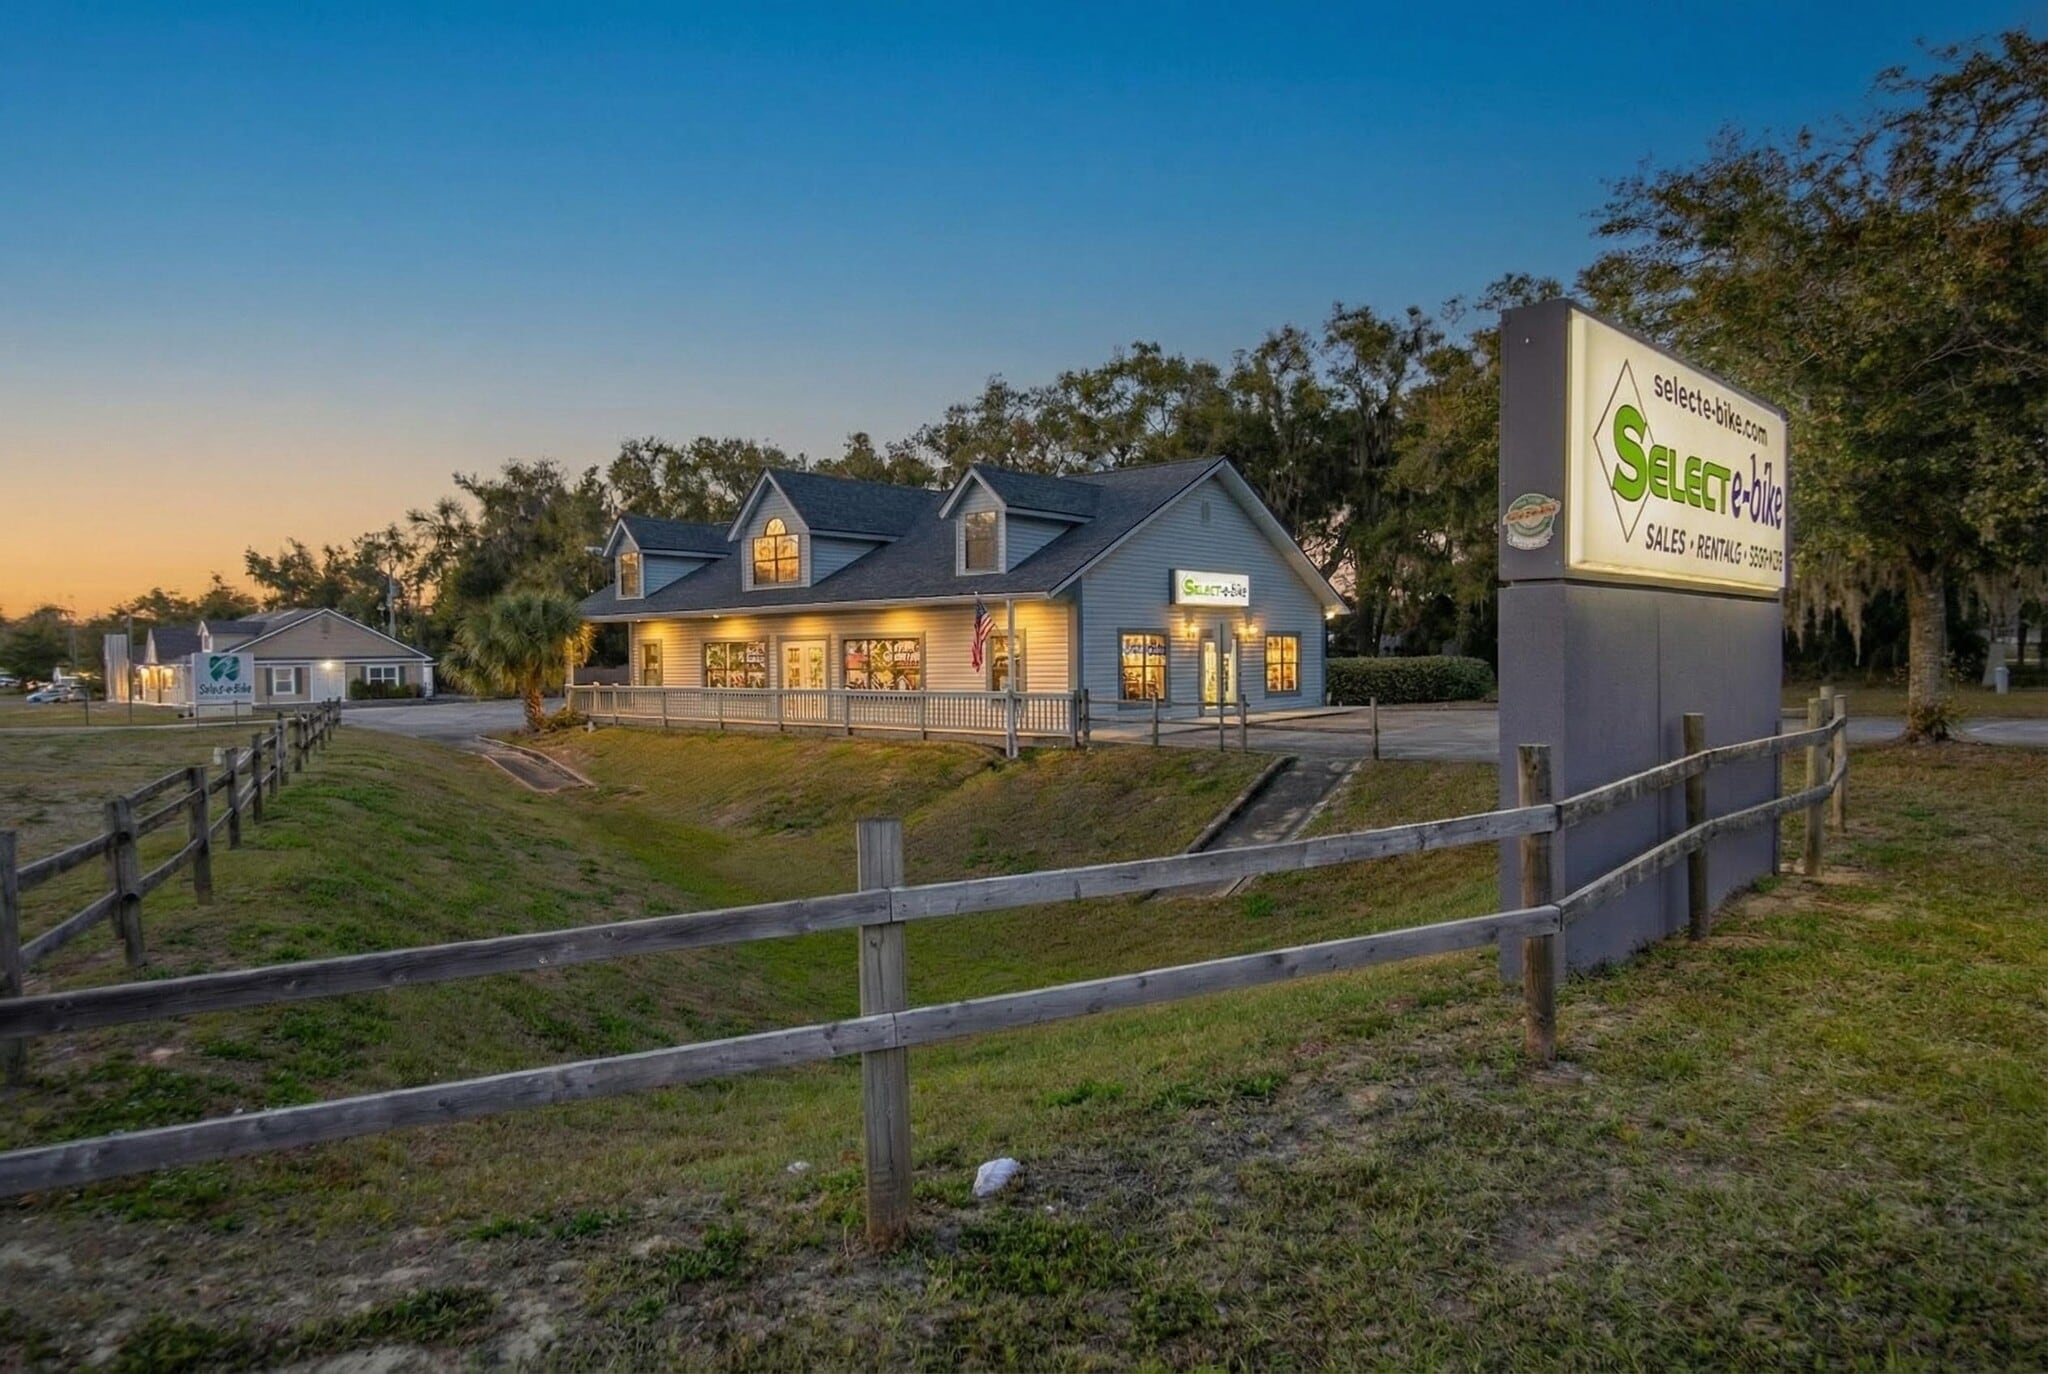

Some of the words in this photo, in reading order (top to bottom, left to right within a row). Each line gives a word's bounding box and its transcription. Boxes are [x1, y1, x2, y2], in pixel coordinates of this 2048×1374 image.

[1654, 374, 1768, 447] selecte-bike.com
[1612, 404, 1731, 515] SELECT
[1645, 523, 1686, 555] SALES
